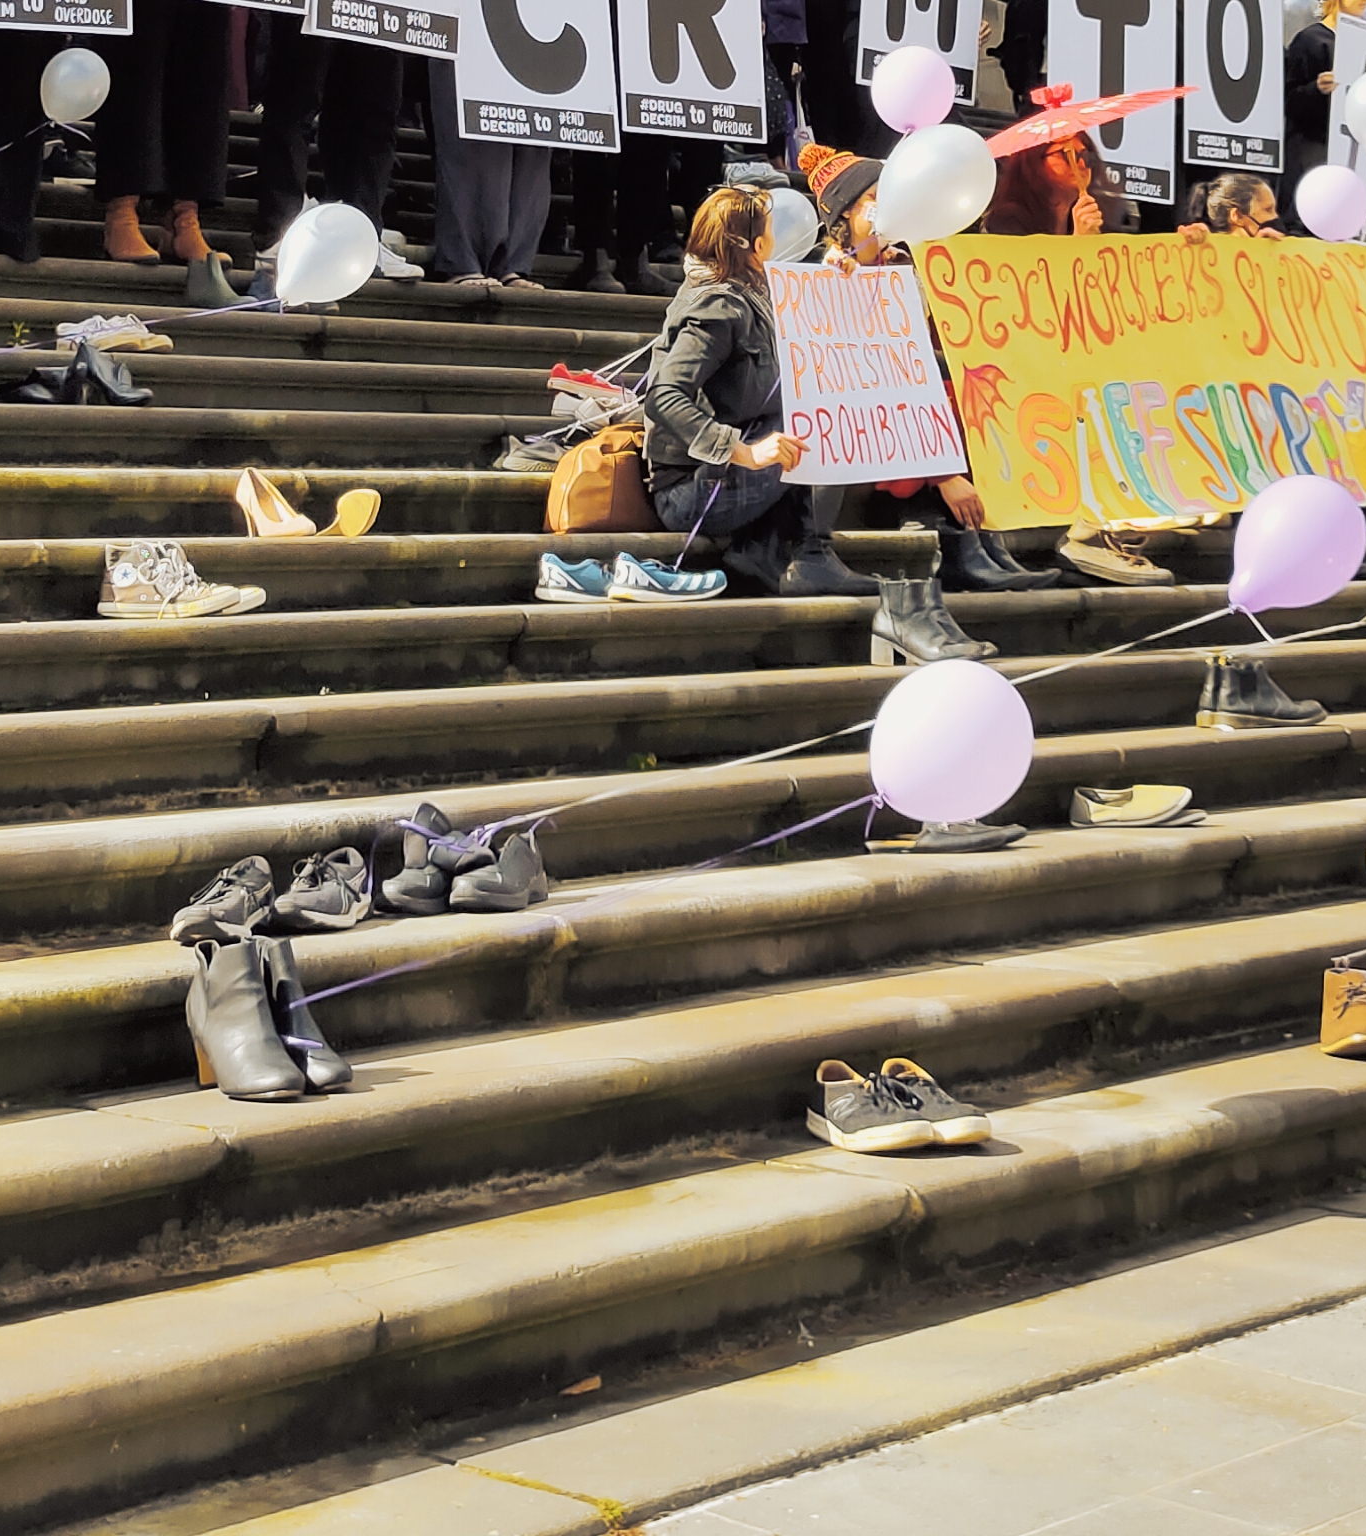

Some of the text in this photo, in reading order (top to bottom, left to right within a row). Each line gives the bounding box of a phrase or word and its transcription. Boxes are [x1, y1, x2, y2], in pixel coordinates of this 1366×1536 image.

[54, 6, 114, 25] OVERDOSE
[383, 10, 400, 32] to
[406, 11, 431, 29] #END
[332, 14, 449, 49] DECRIM OVERDOSE
[479, 105, 584, 132] #DRUG to #END
[640, 98, 735, 125] #DRUG to #END
[640, 111, 753, 136] DECRIM OVERDOSE
[479, 118, 605, 145] DECRIM OVERDOSE
[1230, 139, 1243, 156] to
[769, 267, 911, 339] PROSTITUTES
[790, 340, 928, 399] PROTESTING
[791, 402, 960, 466] PROHIBITION
[1017, 382, 1218, 524] SAFE
